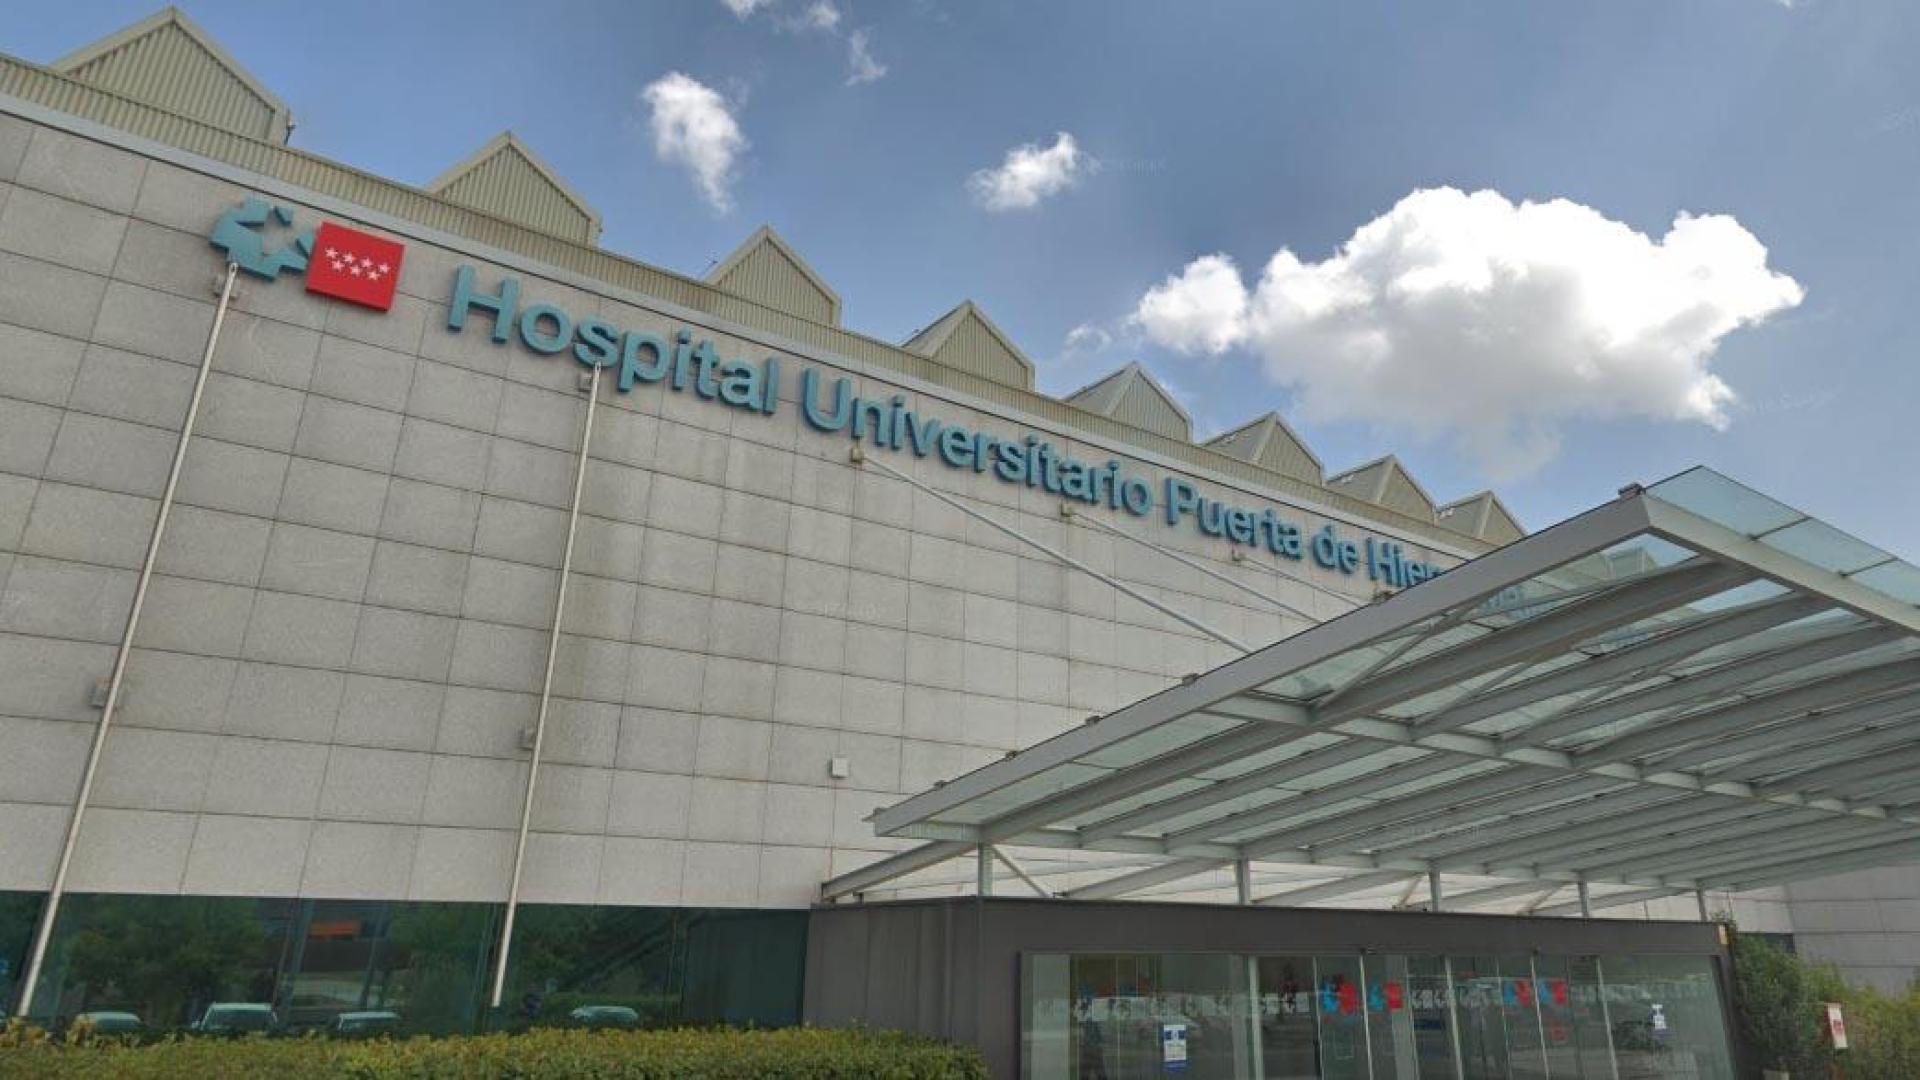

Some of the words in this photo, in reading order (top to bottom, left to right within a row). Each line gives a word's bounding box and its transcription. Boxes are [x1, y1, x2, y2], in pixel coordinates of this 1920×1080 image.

[447, 264, 779, 415] Hospital
[801, 367, 1154, 517] Universitario
[1164, 477, 1304, 560] Puerta
[1312, 525, 1359, 575] de
